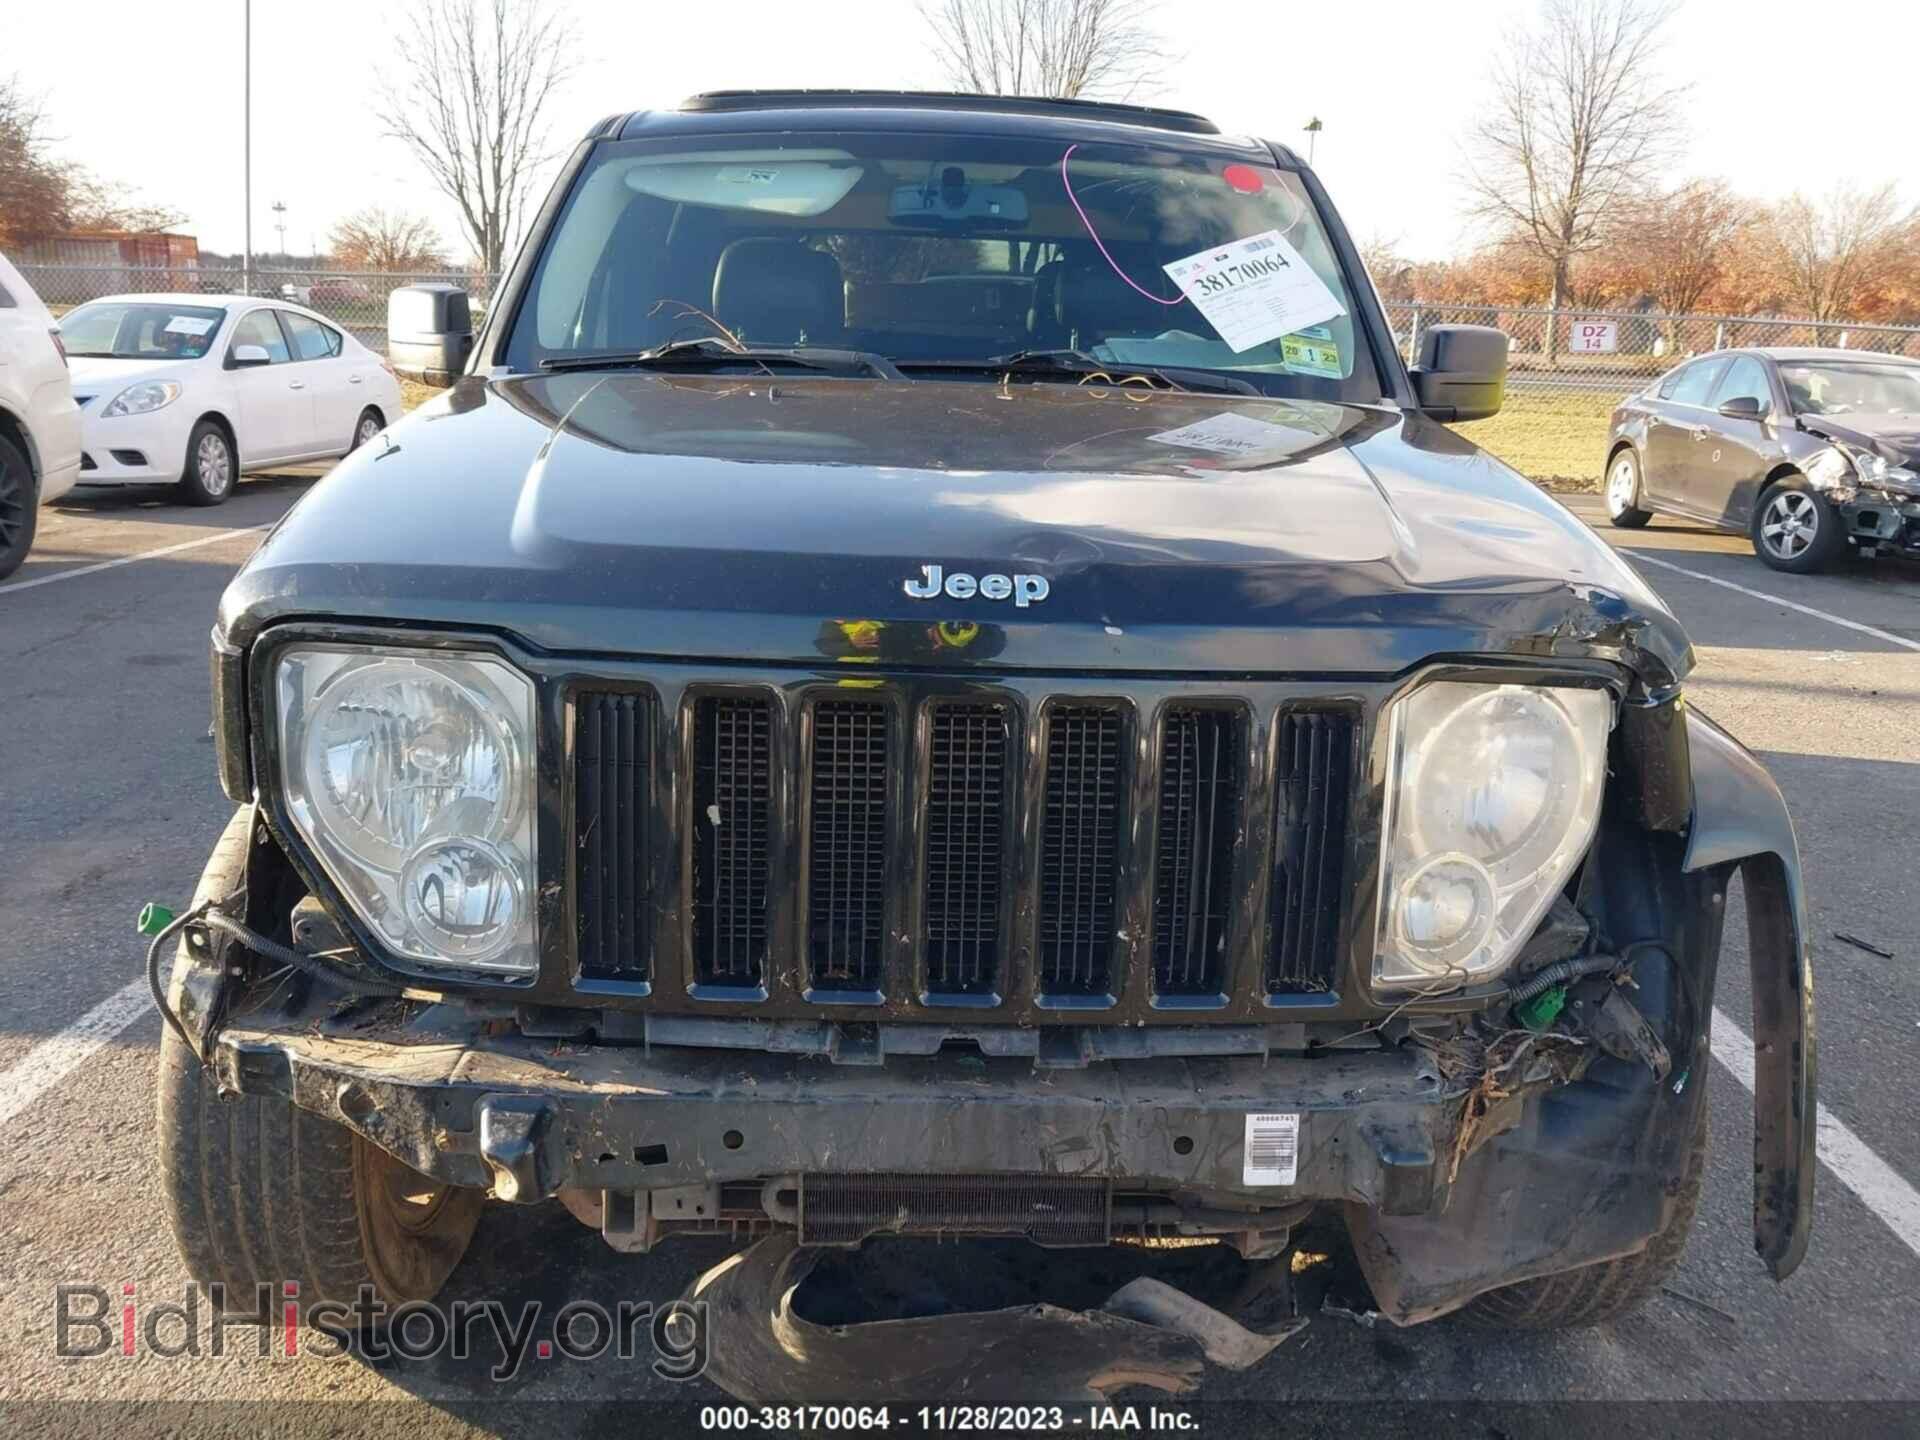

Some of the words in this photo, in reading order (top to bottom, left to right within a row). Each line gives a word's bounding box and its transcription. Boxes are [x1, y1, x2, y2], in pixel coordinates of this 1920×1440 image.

[1194, 252, 1291, 297] 38170064
[1582, 326, 1608, 337] DZ
[1585, 339, 1601, 349] 14
[904, 565, 1050, 608] Jeep
